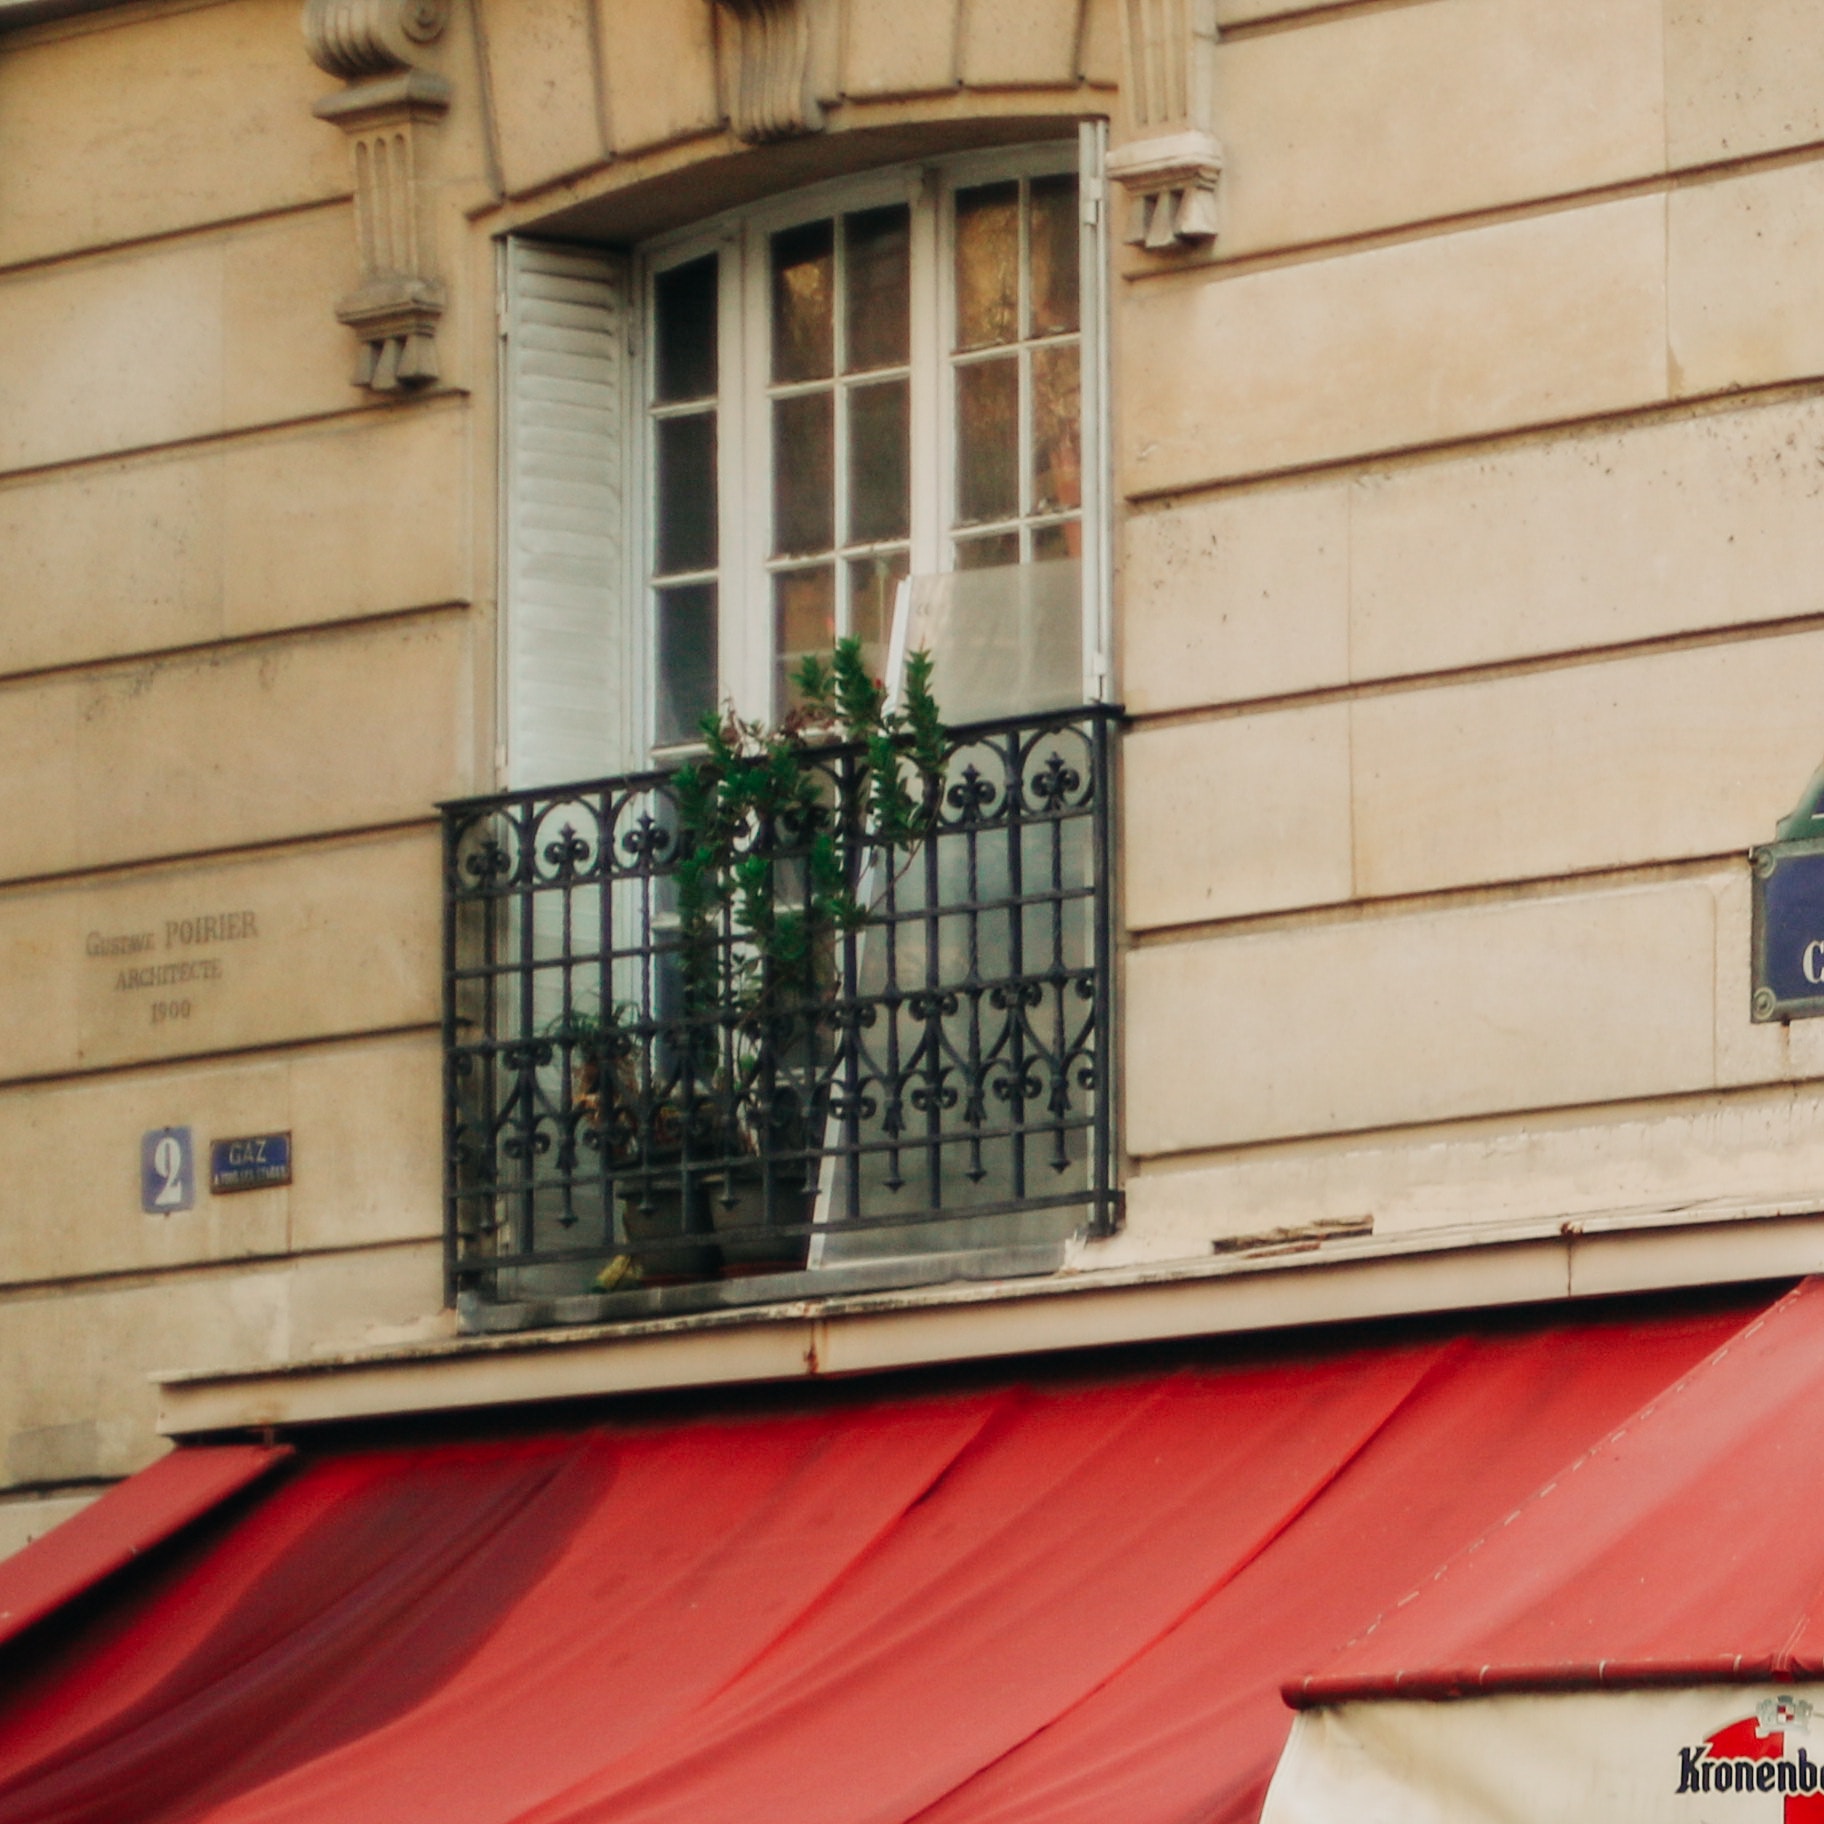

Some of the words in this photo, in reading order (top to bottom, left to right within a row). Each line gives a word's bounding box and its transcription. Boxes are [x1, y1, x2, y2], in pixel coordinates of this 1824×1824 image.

[165, 911, 259, 949] POIRIER
[114, 959, 223, 991] ARCHITECTE
[229, 1139, 267, 1166] GAZ
[154, 1136, 182, 1206] 2
